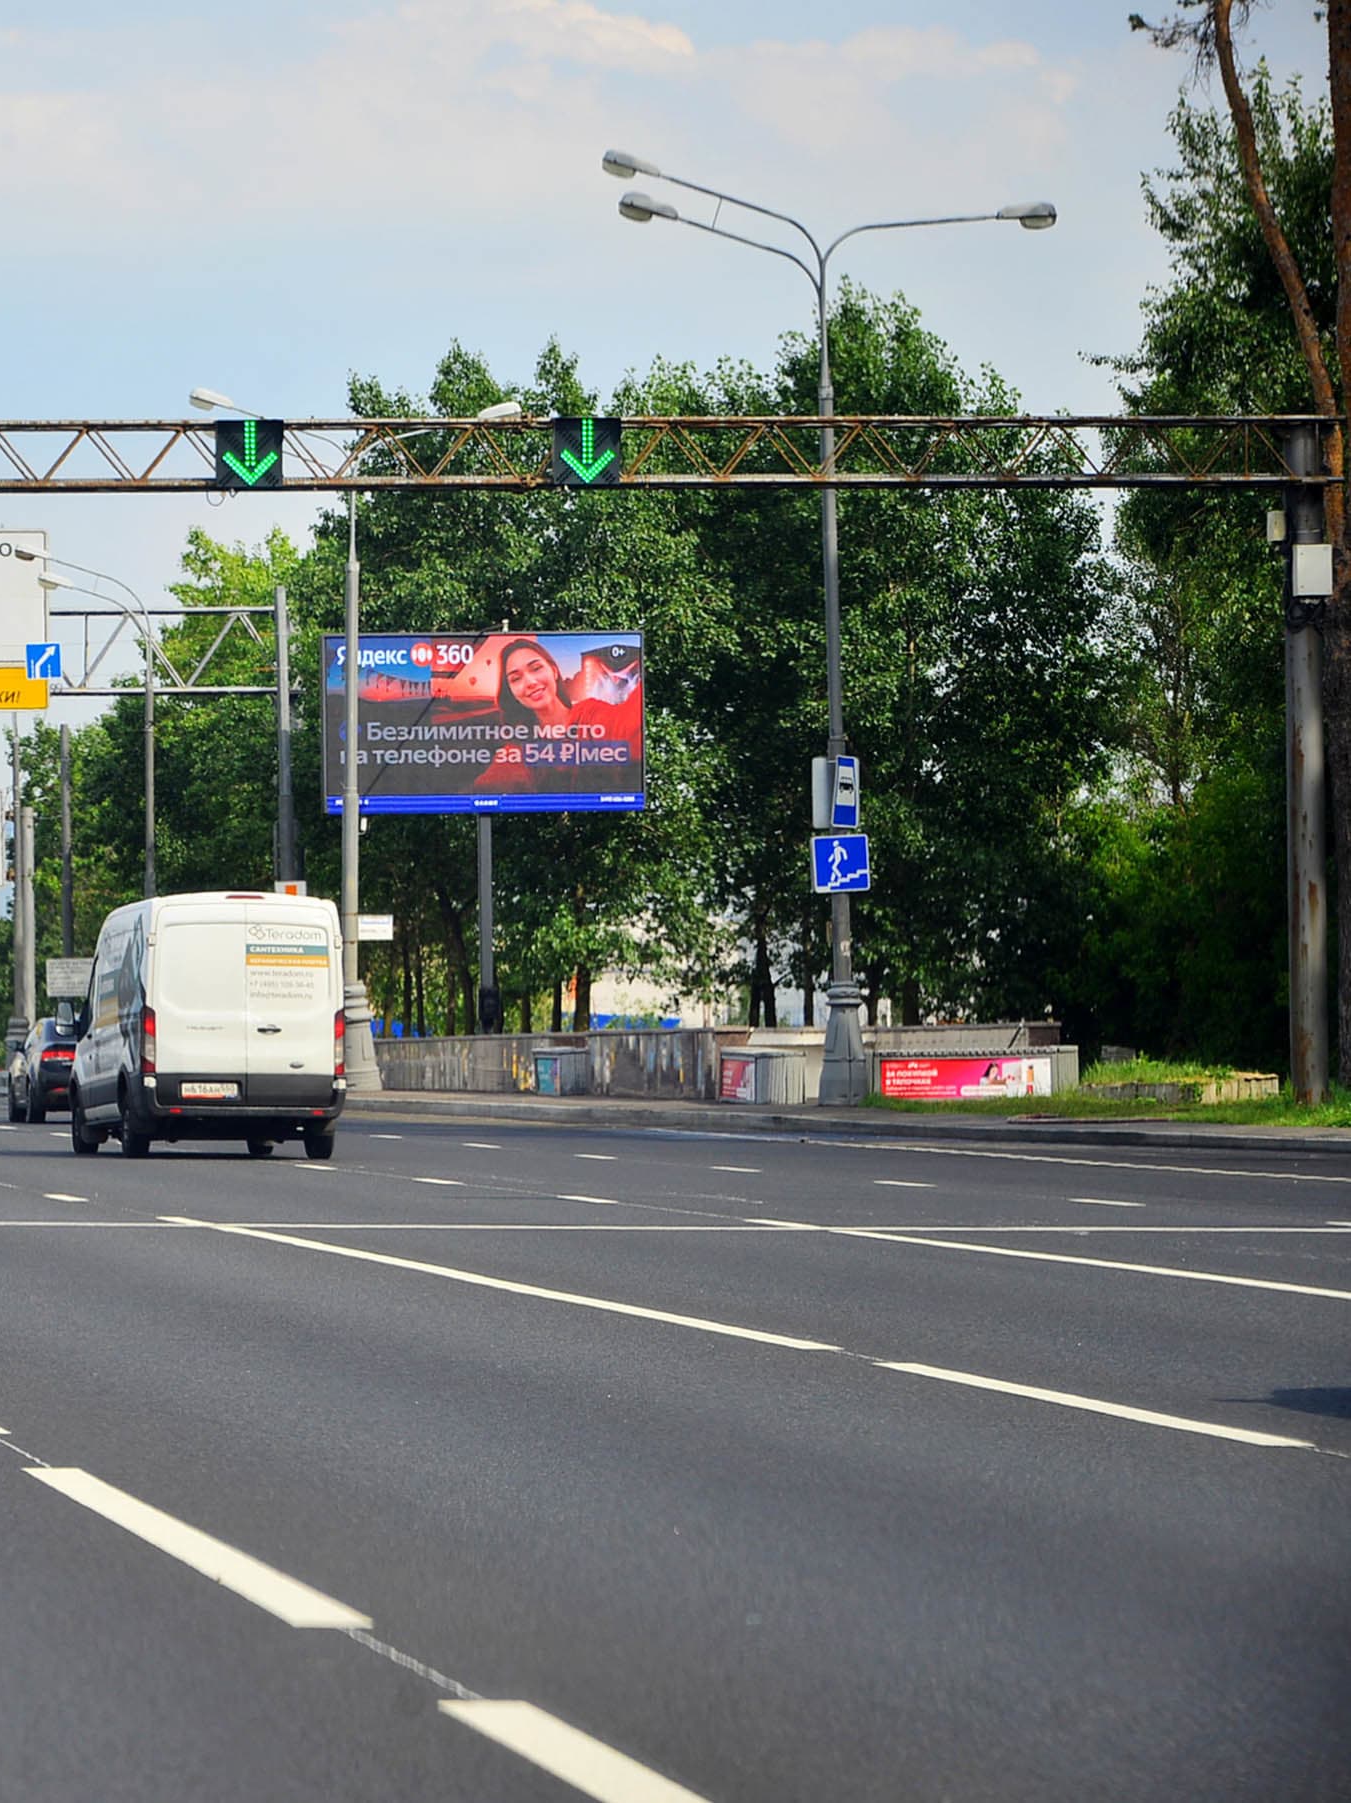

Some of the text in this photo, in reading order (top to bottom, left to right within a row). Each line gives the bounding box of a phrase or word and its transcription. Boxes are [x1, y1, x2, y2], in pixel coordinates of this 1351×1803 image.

[336, 644, 474, 668] Ядекс 360
[611, 646, 626, 657] 0+
[366, 721, 606, 741] Безлимитное место
[372, 744, 491, 768] телефоне
[495, 748, 521, 763] за
[525, 743, 555, 763] 54
[265, 927, 322, 941] Teradom
